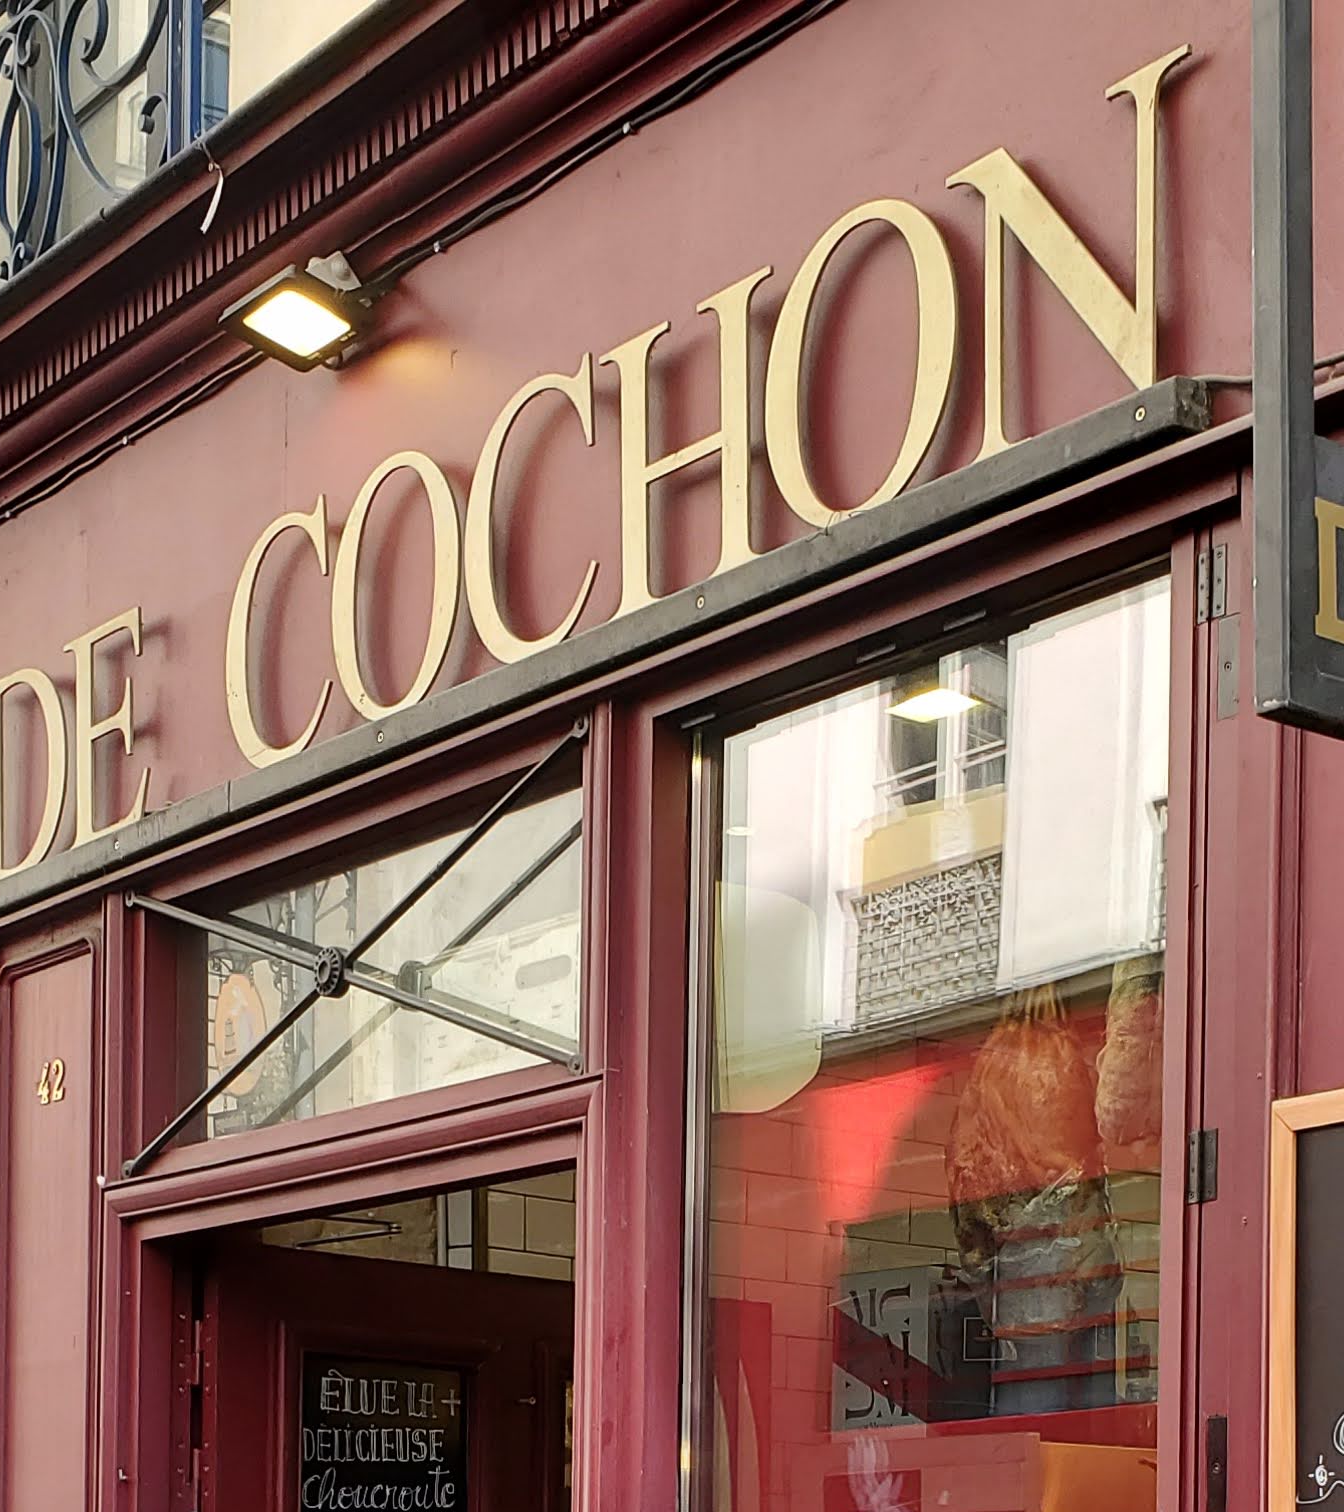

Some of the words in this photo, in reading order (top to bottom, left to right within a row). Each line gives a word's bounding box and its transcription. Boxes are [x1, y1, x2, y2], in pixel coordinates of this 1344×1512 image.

[225, 44, 1193, 770] COCHON
[36, 1057, 67, 1106] 42
[301, 1466, 457, 1511] Choucroute
